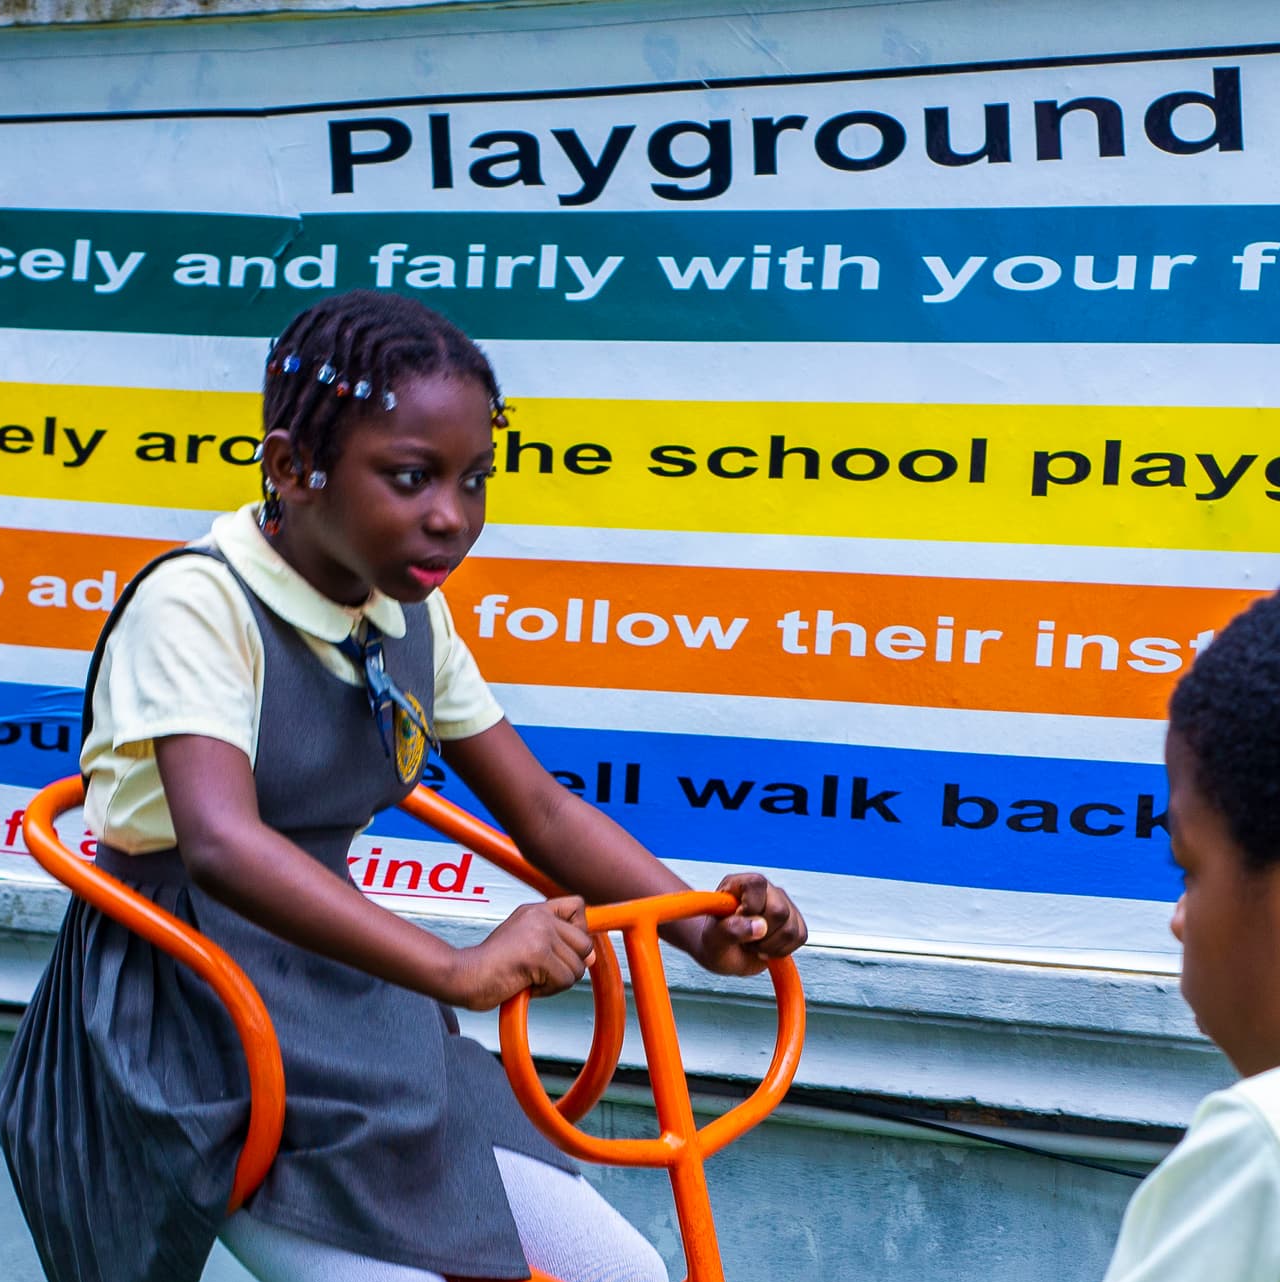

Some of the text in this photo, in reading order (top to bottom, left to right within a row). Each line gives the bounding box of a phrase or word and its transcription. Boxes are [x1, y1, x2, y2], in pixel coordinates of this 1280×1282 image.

[327, 65, 1244, 208] Playground
[173, 244, 337, 288] and
[369, 242, 624, 301] fairly
[657, 242, 881, 291] with
[921, 246, 1198, 304] your
[646, 434, 989, 484] school
[472, 593, 750, 651] follow
[775, 608, 1005, 665] their
[677, 772, 901, 824] walk
